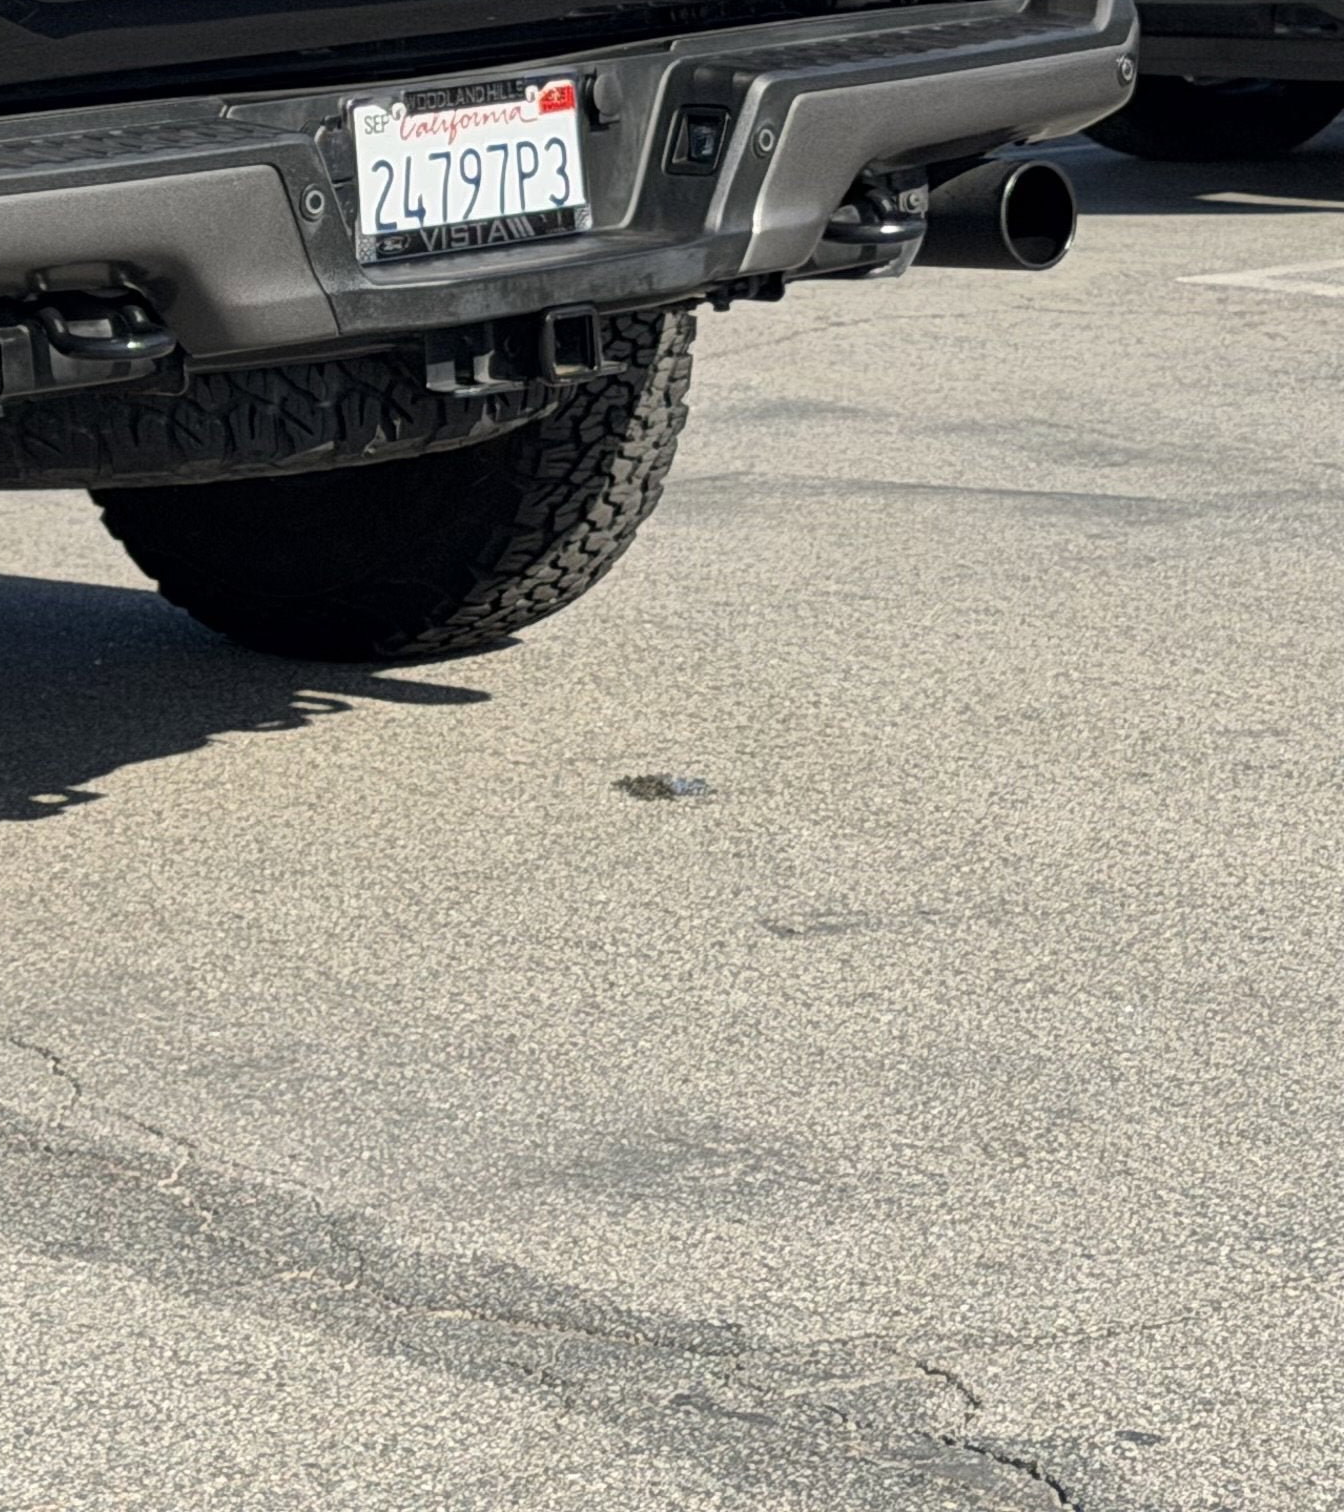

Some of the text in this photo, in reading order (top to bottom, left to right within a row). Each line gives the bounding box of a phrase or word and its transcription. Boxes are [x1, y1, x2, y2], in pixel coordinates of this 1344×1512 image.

[406, 80, 525, 111] WOODLAND HILLS
[363, 114, 390, 135] SEP
[399, 105, 539, 146] California
[371, 136, 570, 232] 24797P3
[420, 216, 511, 252] VISTA
